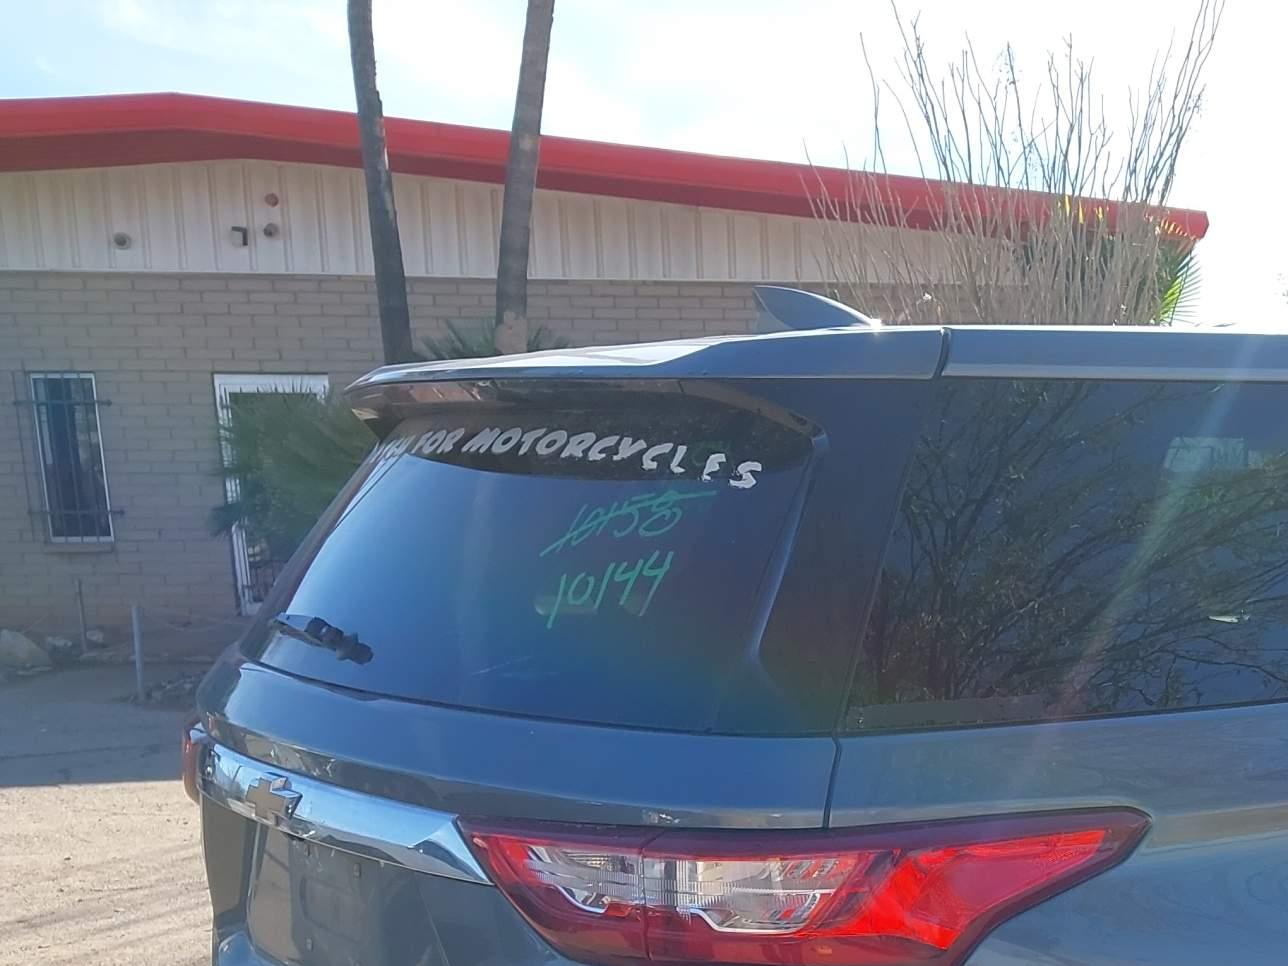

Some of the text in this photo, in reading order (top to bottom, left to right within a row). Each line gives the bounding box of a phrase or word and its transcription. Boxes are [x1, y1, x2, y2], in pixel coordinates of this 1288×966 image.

[410, 427, 465, 454] FOR
[461, 427, 762, 489] MOTORCYCLES
[547, 550, 674, 629] 10144
